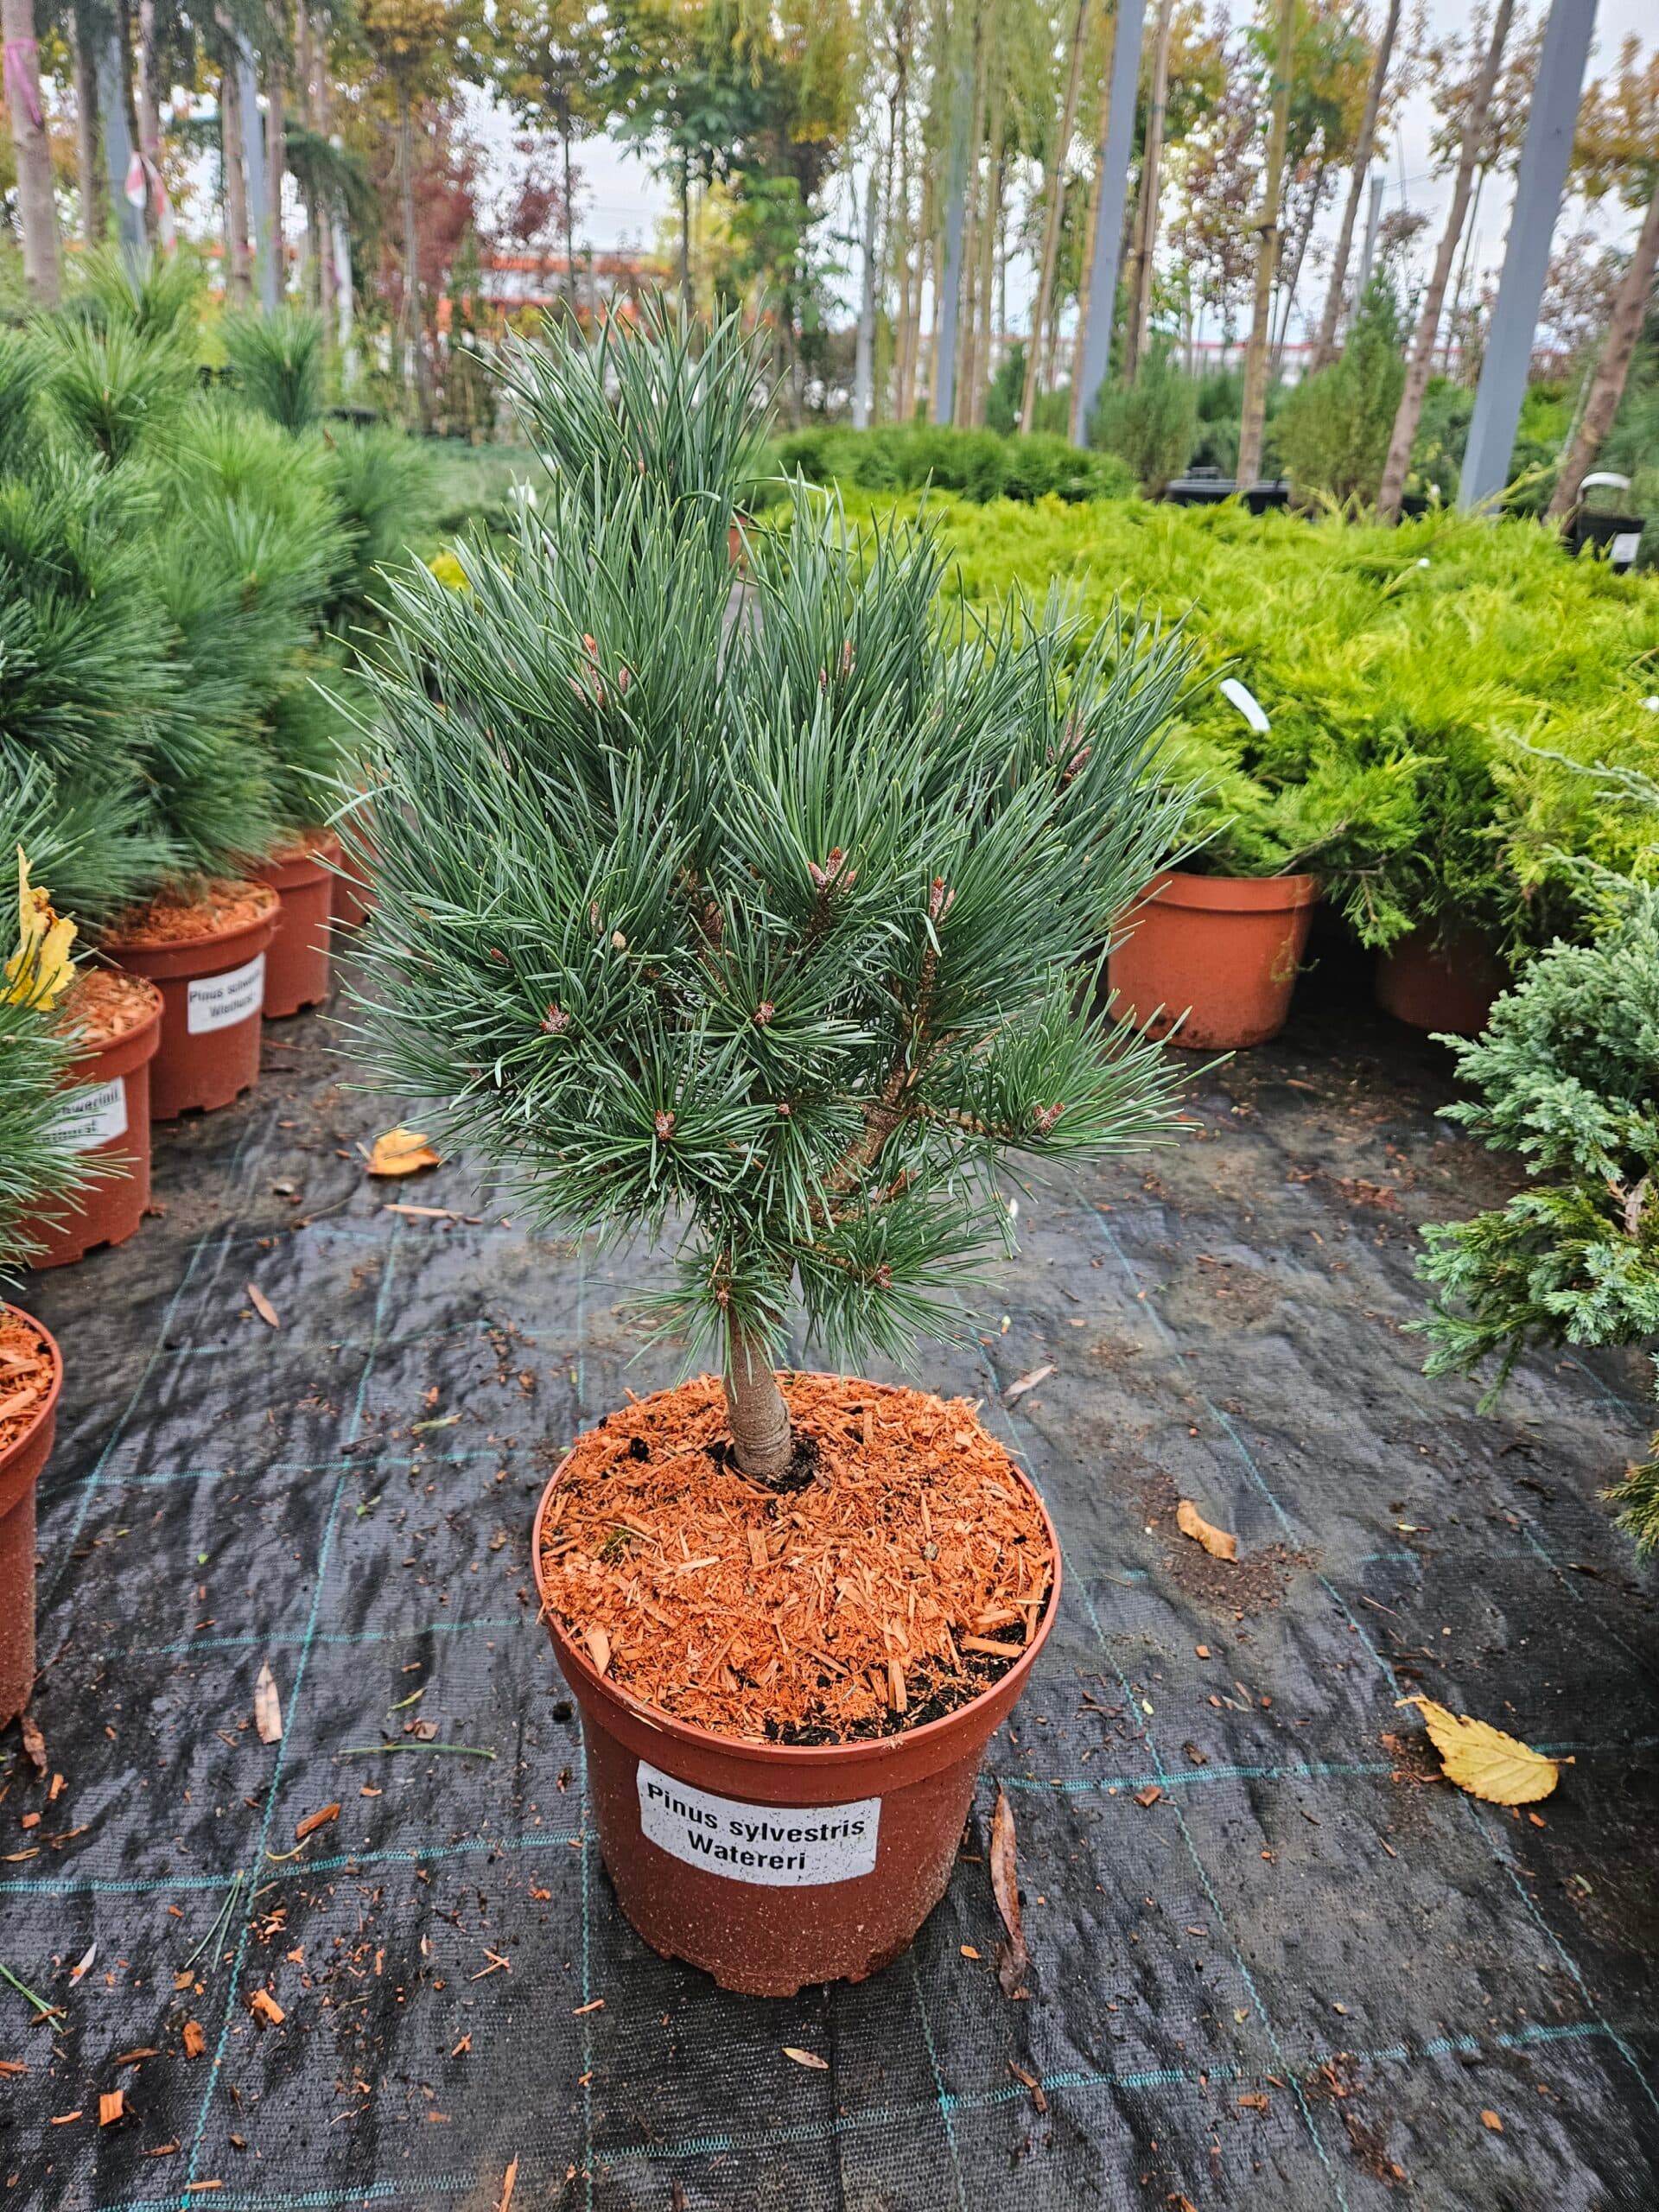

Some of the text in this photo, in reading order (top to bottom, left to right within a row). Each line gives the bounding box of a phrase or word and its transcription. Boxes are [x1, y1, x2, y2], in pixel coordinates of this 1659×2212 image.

[647, 1782, 865, 1843] Pinus sylvestris
[688, 1829, 805, 1870] Watereri
